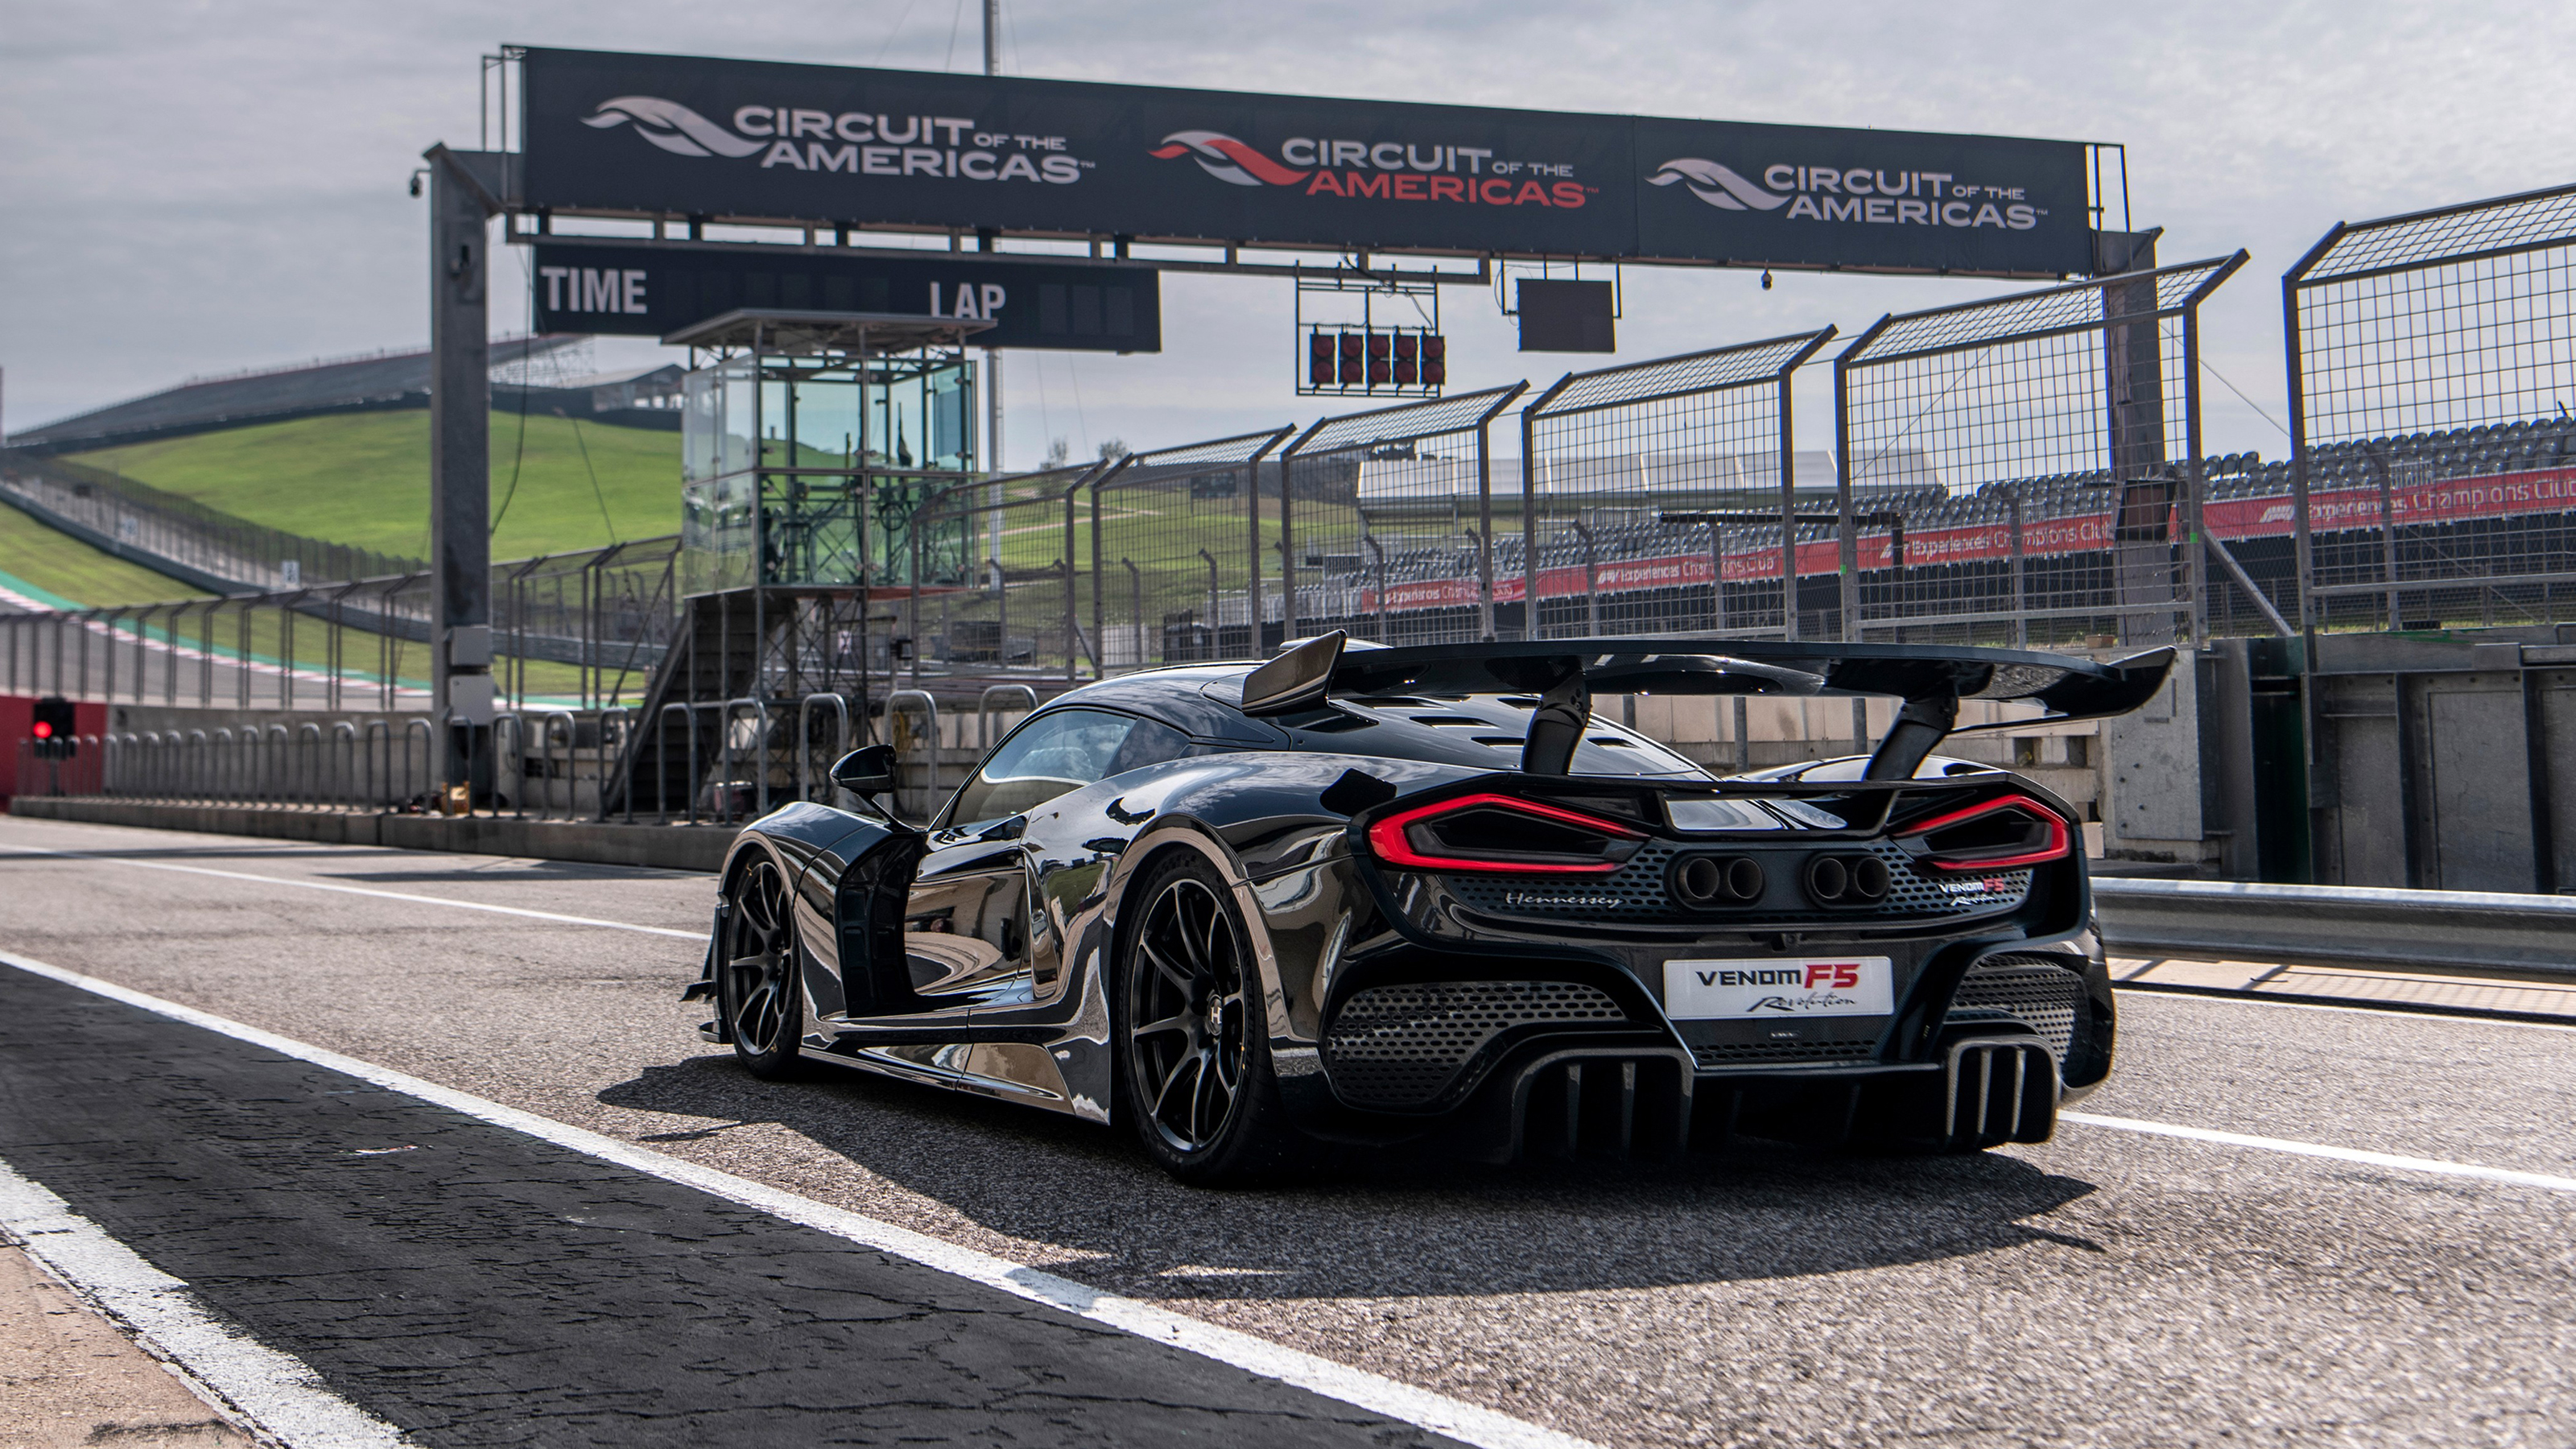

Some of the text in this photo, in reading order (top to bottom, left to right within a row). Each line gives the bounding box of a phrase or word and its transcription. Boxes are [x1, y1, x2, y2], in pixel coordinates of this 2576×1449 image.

[733, 105, 1067, 151] CIRCUIT OF THE
[1282, 138, 1574, 177] CIRCUIT OF THE
[1764, 163, 2025, 200] CIRCUIT OF THE
[540, 267, 647, 314] TIME
[930, 282, 1006, 320] LAP
[2413, 484, 2529, 511] Champions
[1994, 526, 2077, 548] Chmpions
[1746, 557, 1774, 572] Cub
[1938, 877, 2004, 894] VENOM F5
[1505, 892, 1624, 909] Hennessey
[1695, 964, 1861, 989] VENOM F5
[1746, 991, 1856, 1013] Revolution
